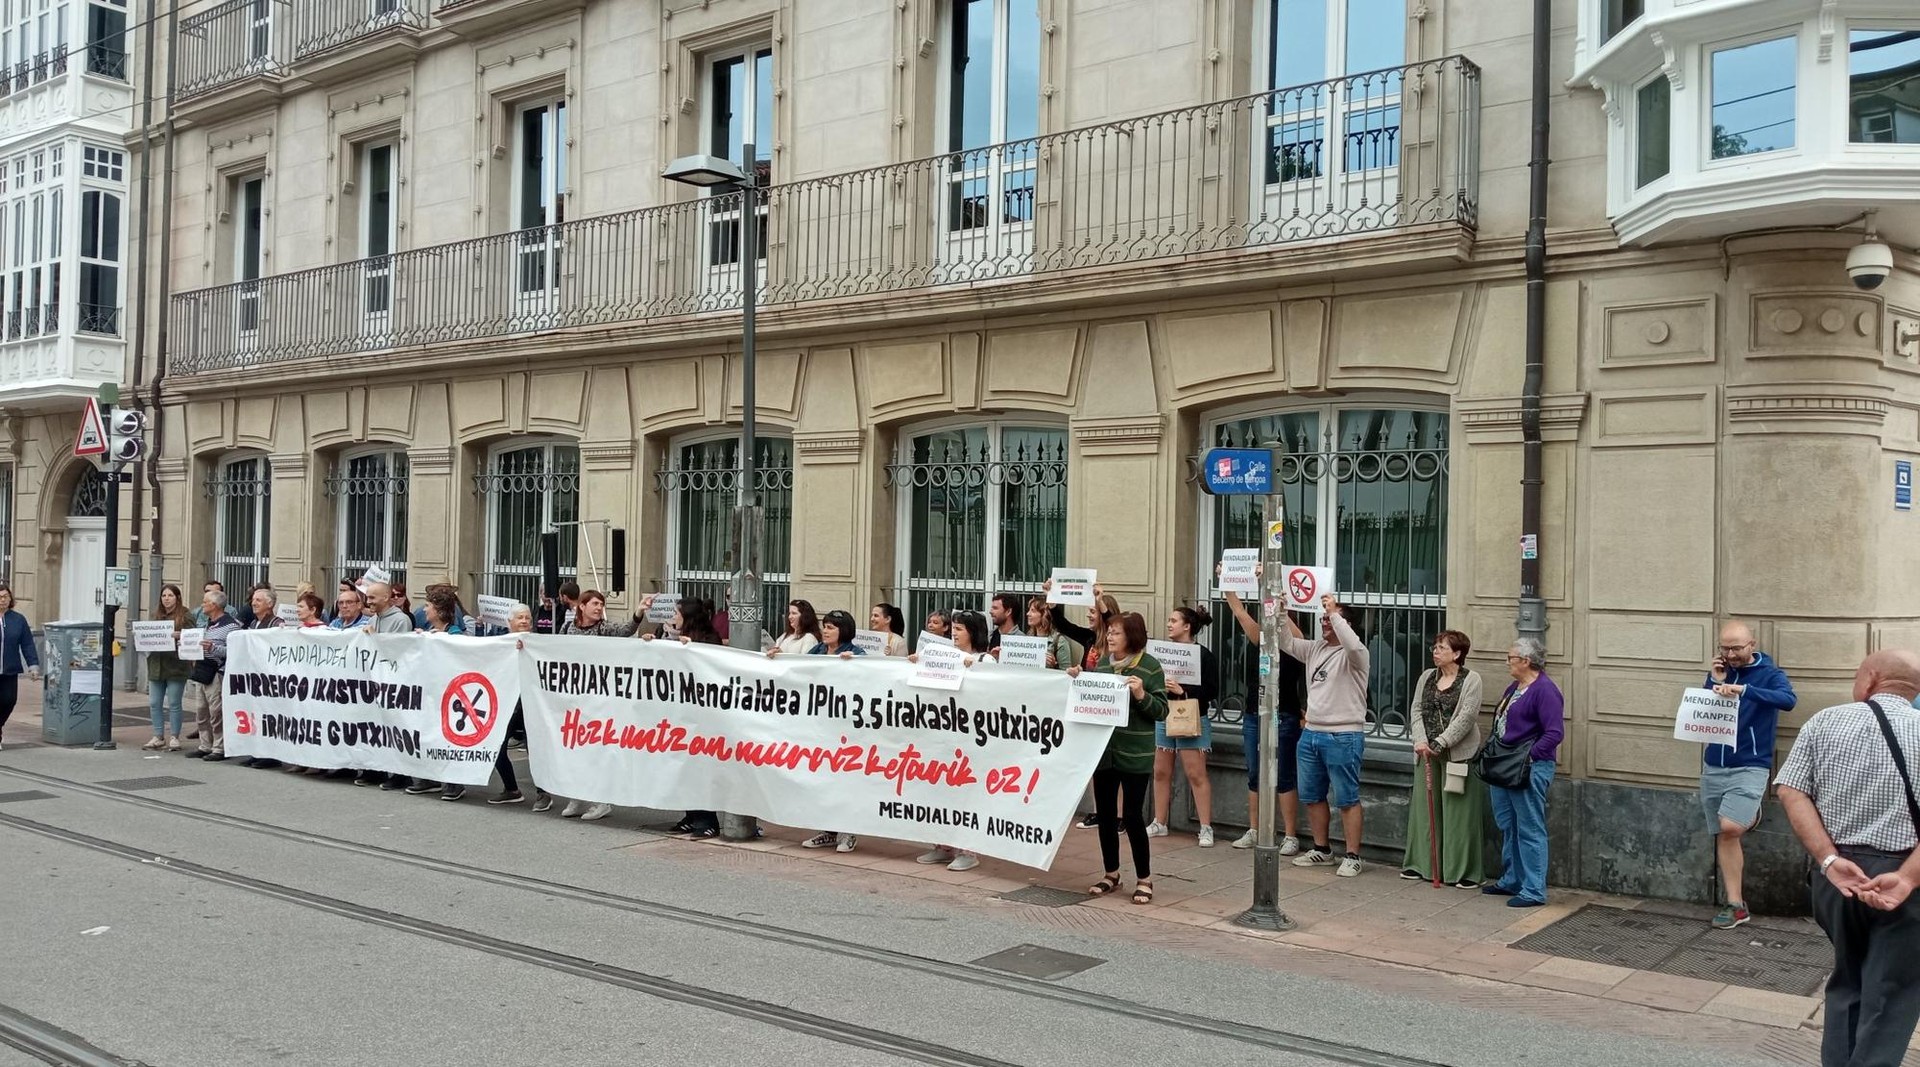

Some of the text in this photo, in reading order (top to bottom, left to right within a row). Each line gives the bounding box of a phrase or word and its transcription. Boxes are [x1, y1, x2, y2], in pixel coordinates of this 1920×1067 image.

[1249, 460, 1266, 472] Calle
[1236, 474, 1243, 484] de
[268, 644, 348, 668] MENDIALDEA
[924, 649, 960, 658] HEZKUNTZA
[1154, 646, 1191, 657] HEZKUNTZA
[1072, 679, 1115, 689] MENDIALDEA
[1080, 693, 1116, 704] (KANPEZU)
[1684, 696, 1738, 709] MENDIALDE
[537, 660, 610, 696] HERRIAK
[614, 666, 633, 699] EZ
[637, 668, 675, 702] ITO!
[679, 672, 800, 715] Mendialdea
[852, 693, 883, 730] 3.5
[886, 689, 969, 734] irakasle
[973, 704, 1064, 755] gutxiago
[327, 720, 421, 759] GUTXIAGO!
[736, 736, 977, 796] murrizketarik
[879, 801, 1052, 845] MENDIALDEA AURRERA
